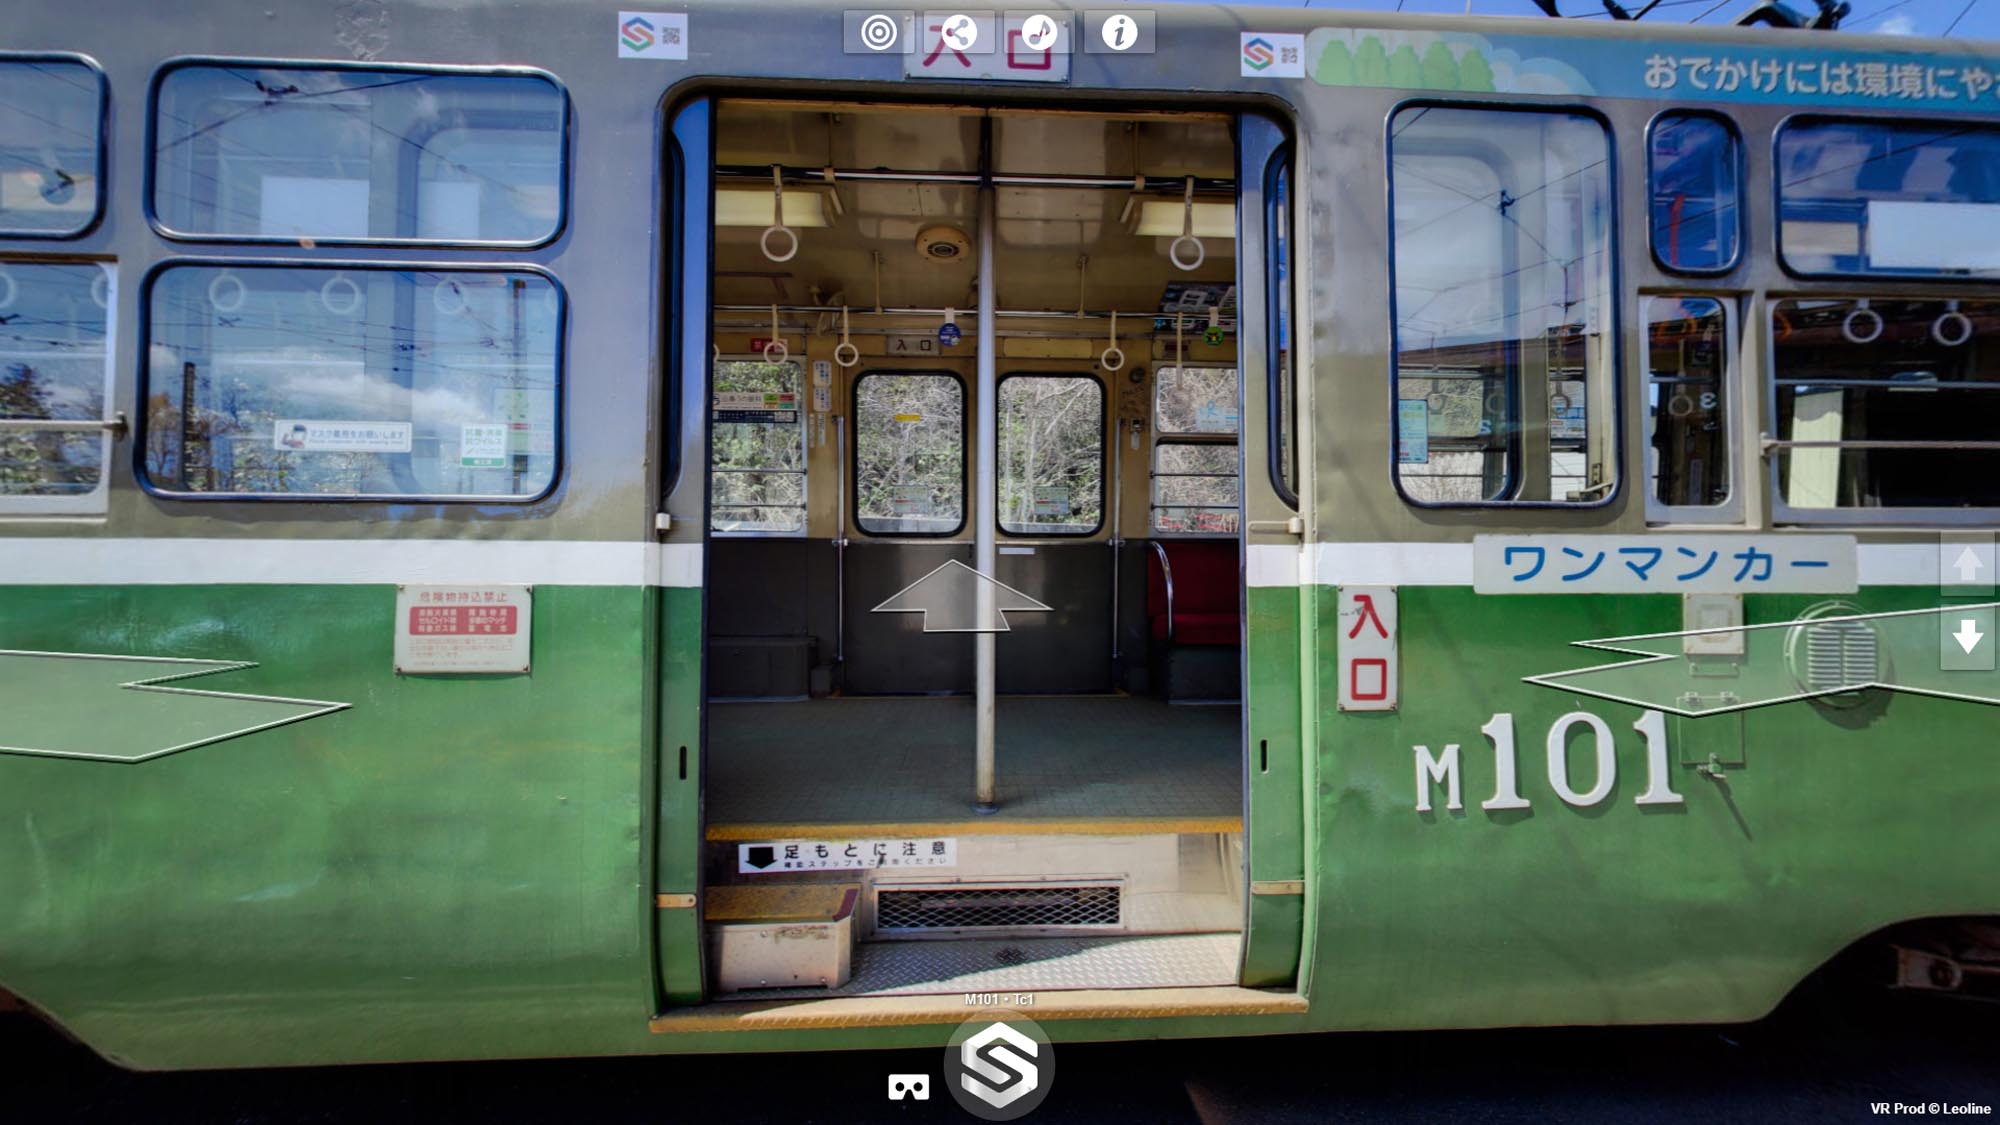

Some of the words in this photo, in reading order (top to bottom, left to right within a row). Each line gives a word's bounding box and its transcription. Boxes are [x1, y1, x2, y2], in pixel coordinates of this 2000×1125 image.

[1644, 53, 2000, 101] おでかけには環境にや
[1503, 545, 1830, 582] ワンマンカー
[419, 591, 508, 603] 危険物持込禁止
[1348, 594, 1390, 700] 入口
[1413, 710, 1684, 811] M101
[784, 841, 946, 860] 足もとに注意
